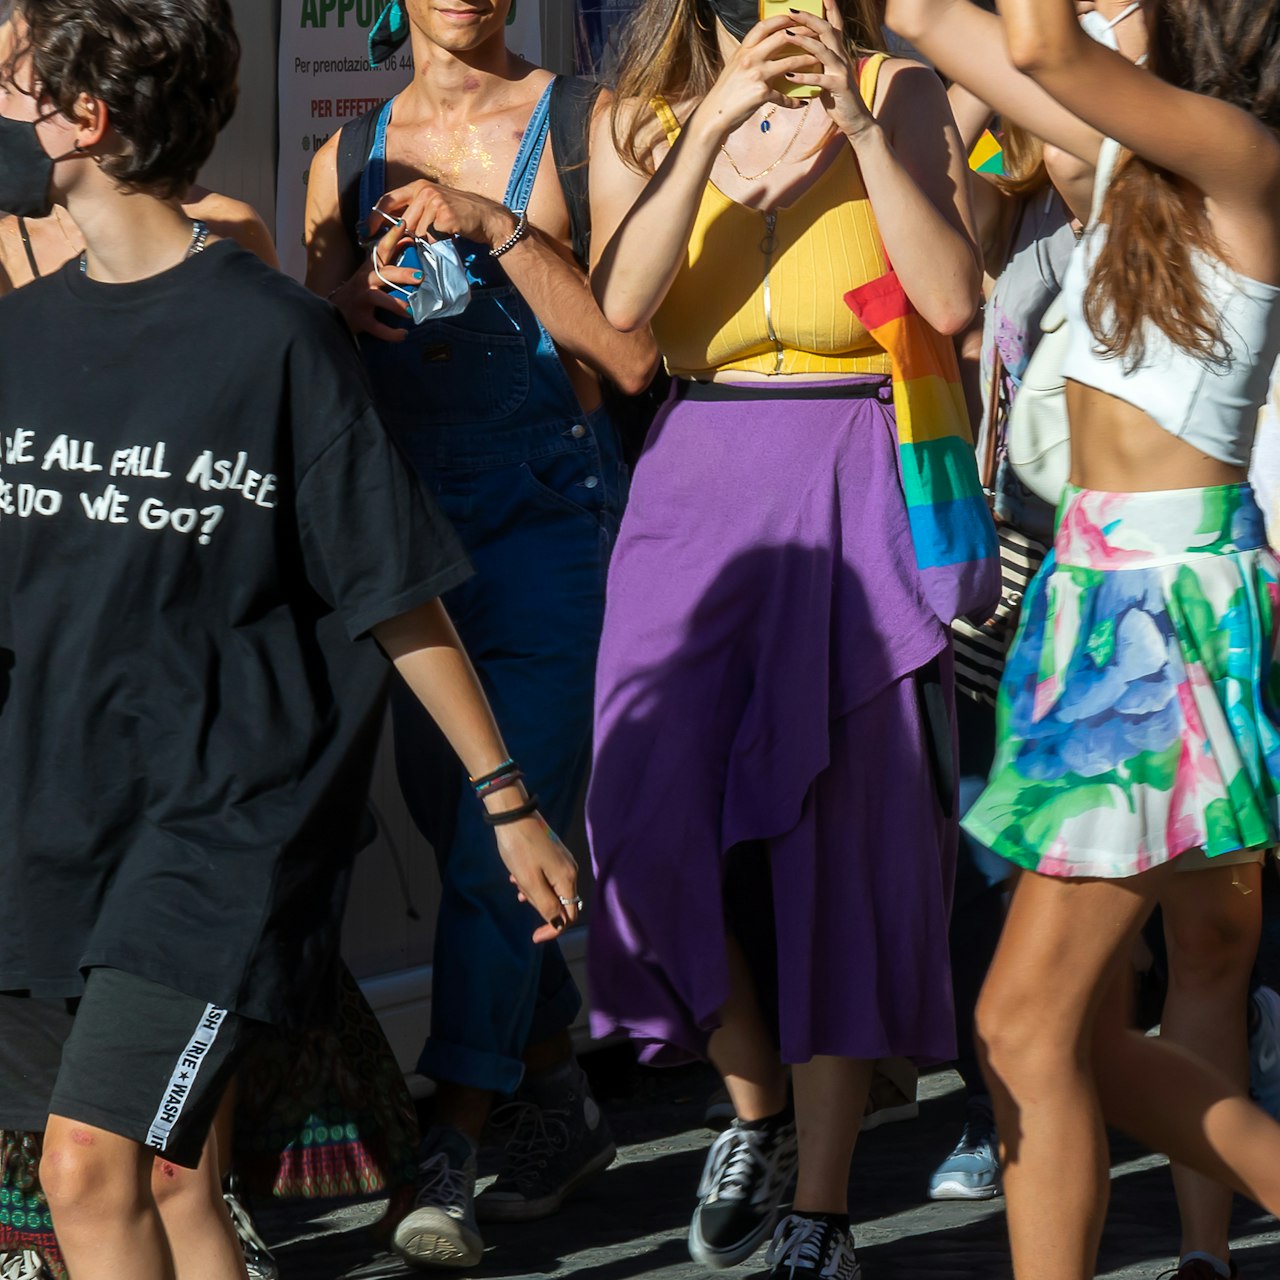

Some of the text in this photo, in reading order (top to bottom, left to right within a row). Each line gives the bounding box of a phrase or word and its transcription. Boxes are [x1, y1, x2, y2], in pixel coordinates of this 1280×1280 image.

[295, 57, 311, 73] Per
[311, 99, 332, 118] PER
[41, 433, 103, 473] ALL
[109, 441, 172, 478] FALL
[185, 449, 278, 509] ASLEE
[17, 483, 63, 517] DO
[79, 484, 130, 524] WE
[138, 497, 225, 546] GO?
[160, 1084, 188, 1124] WASH
